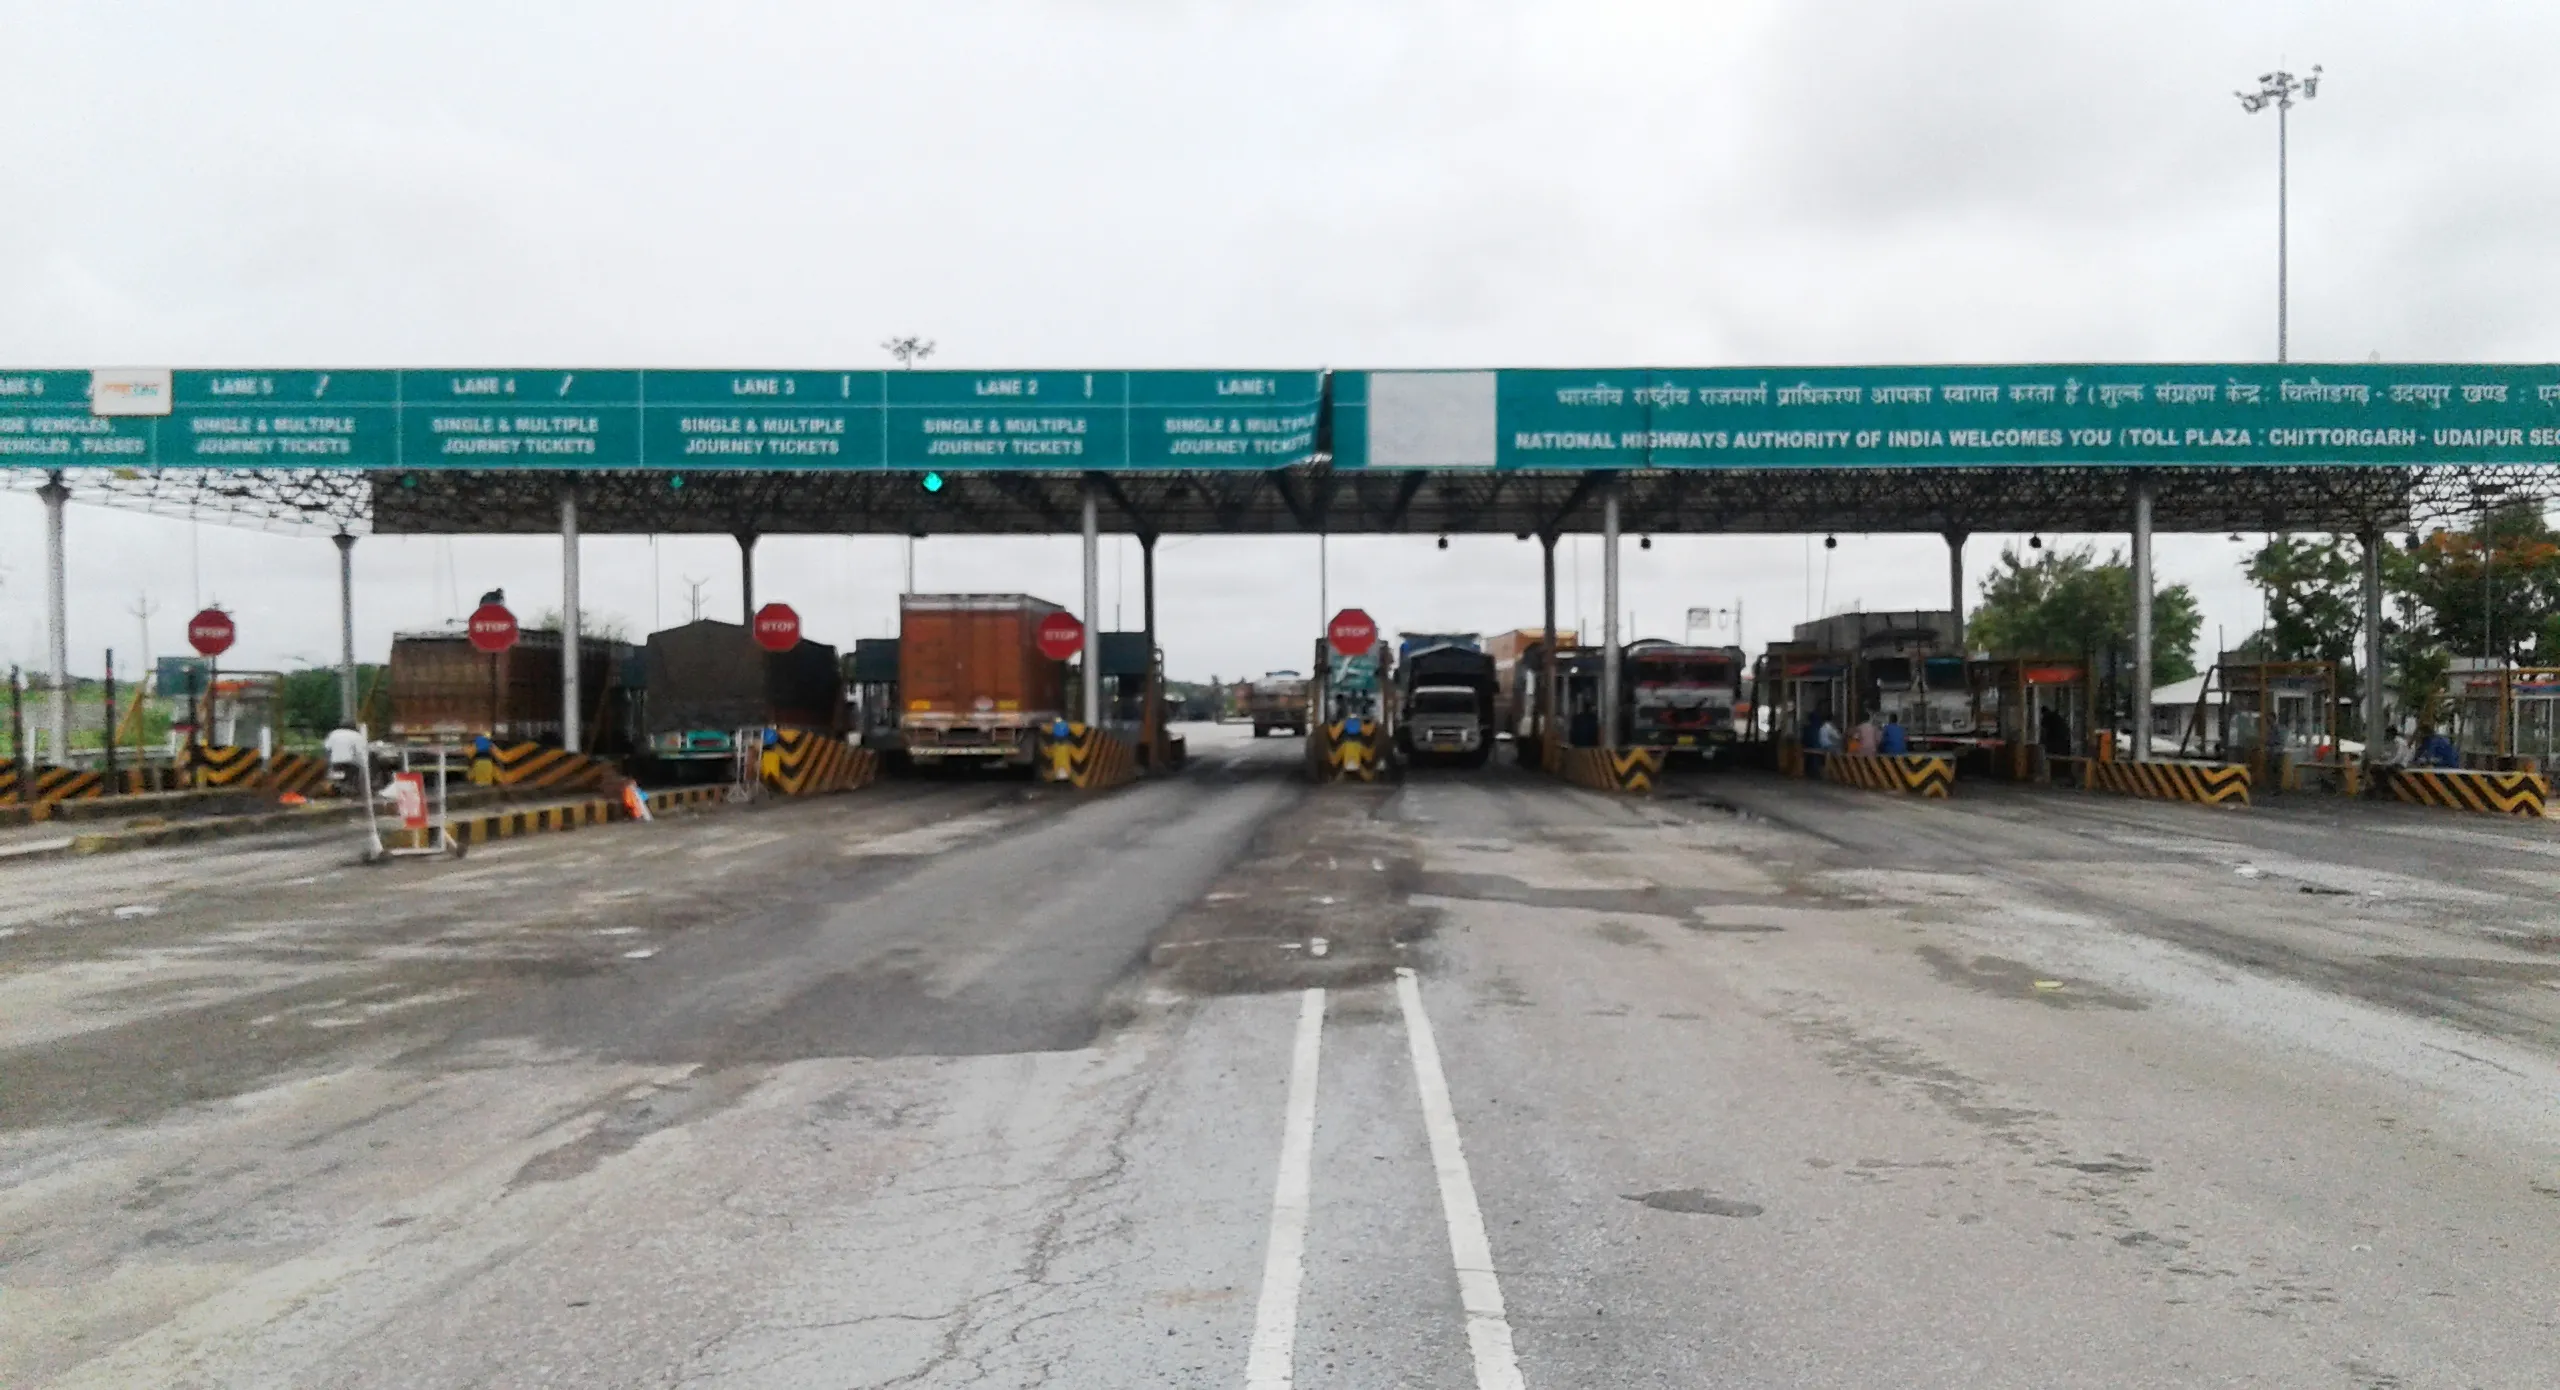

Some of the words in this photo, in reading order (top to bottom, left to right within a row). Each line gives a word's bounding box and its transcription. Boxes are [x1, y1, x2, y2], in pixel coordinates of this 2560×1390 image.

[211, 378, 257, 395] LANE
[453, 377, 499, 394] LANE
[505, 379, 515, 393] 4
[733, 378, 778, 395] LANE
[785, 379, 795, 394] 3
[976, 379, 1021, 395] LANE
[1028, 379, 1038, 395] 2
[1218, 379, 1264, 395] LANE
[1267, 380, 1276, 395] 1
[1557, 382, 1624, 405] भारतीय
[1634, 382, 1690, 408] राष्ट्रीय
[1699, 379, 1768, 404] राजमार्ग
[1777, 381, 1862, 406] प्राधिकरण
[1871, 386, 1932, 404] आपका
[1942, 385, 2000, 403] स्वागत
[2009, 385, 2056, 402] करता
[2065, 378, 2082, 405] है
[2154, 382, 2217, 403] संग्रहण
[2389, 384, 2452, 409] उदयपुर
[273, 417, 354, 433] MULTIPLE
[432, 417, 491, 433] SINGLE
[498, 418, 510, 433] &
[515, 417, 598, 433] MULTIPLE
[681, 418, 741, 433] SINGLE
[746, 418, 758, 433] &
[763, 418, 844, 433] MULTIPLE
[924, 418, 983, 434] SINGLE
[989, 419, 1000, 434] &
[1005, 418, 1086, 434] MULTIPLE
[1165, 418, 1223, 433] SINGLE
[1230, 419, 1240, 433] &
[443, 438, 521, 454] JOURNEY
[525, 438, 596, 454] TICKETS
[685, 439, 764, 454] JOURNEY
[768, 439, 839, 454] TICKETS
[1172, 439, 1247, 454] JOURNEY
[1515, 431, 1615, 449] NATIONAL
[1621, 431, 1728, 449] HIGHWAYS
[1733, 431, 1851, 448] AUTHORITY
[1855, 430, 1882, 448] OF
[1888, 430, 1943, 448] INDIA
[1949, 428, 2063, 447] WELCOMES
[2069, 428, 2112, 446] YOU
[2185, 428, 2252, 446] PLAZA
[2433, 428, 2524, 447] UDAIPUR
[928, 440, 1006, 455] JOURNEY
[1012, 439, 1082, 454] TICKETS
[474, 621, 511, 633] STOP
[761, 620, 796, 633] STOP
[1335, 625, 1370, 637] STOP
[1044, 629, 1079, 641] STOP
